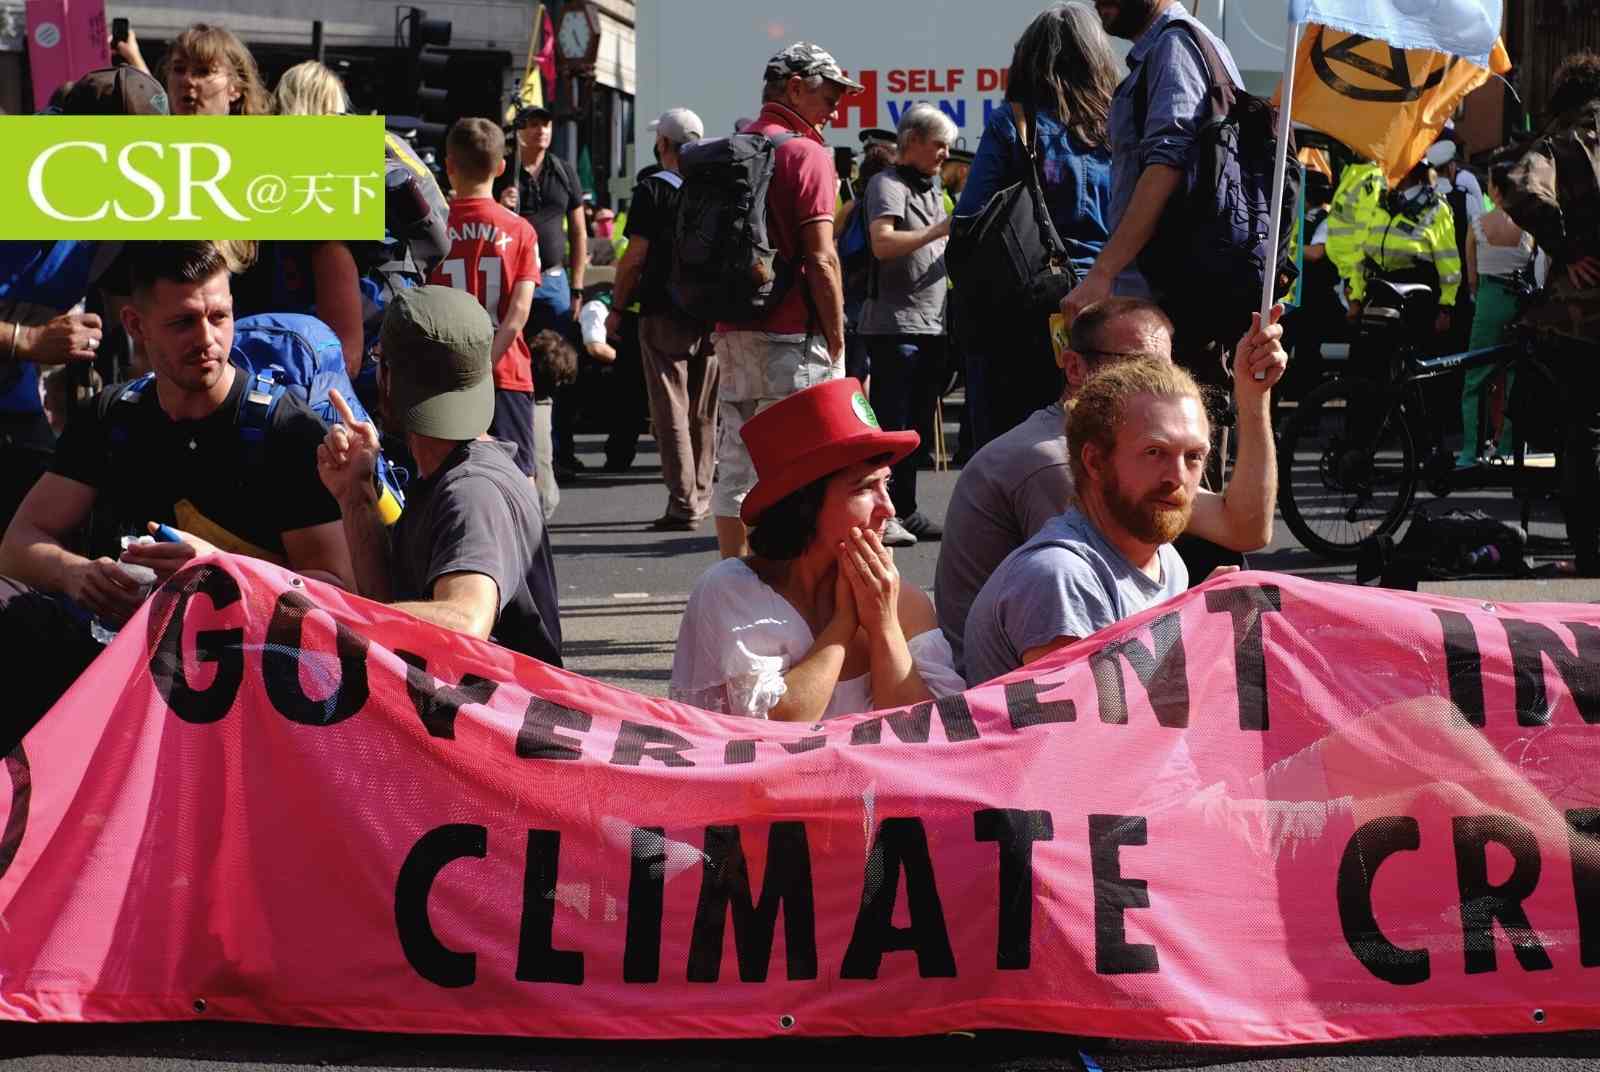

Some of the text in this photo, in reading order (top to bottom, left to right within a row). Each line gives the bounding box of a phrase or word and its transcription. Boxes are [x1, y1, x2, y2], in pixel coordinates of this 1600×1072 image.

[887, 69, 964, 93] SELF
[886, 99, 966, 128] VN
[395, 811, 1160, 988] CLIMATE
